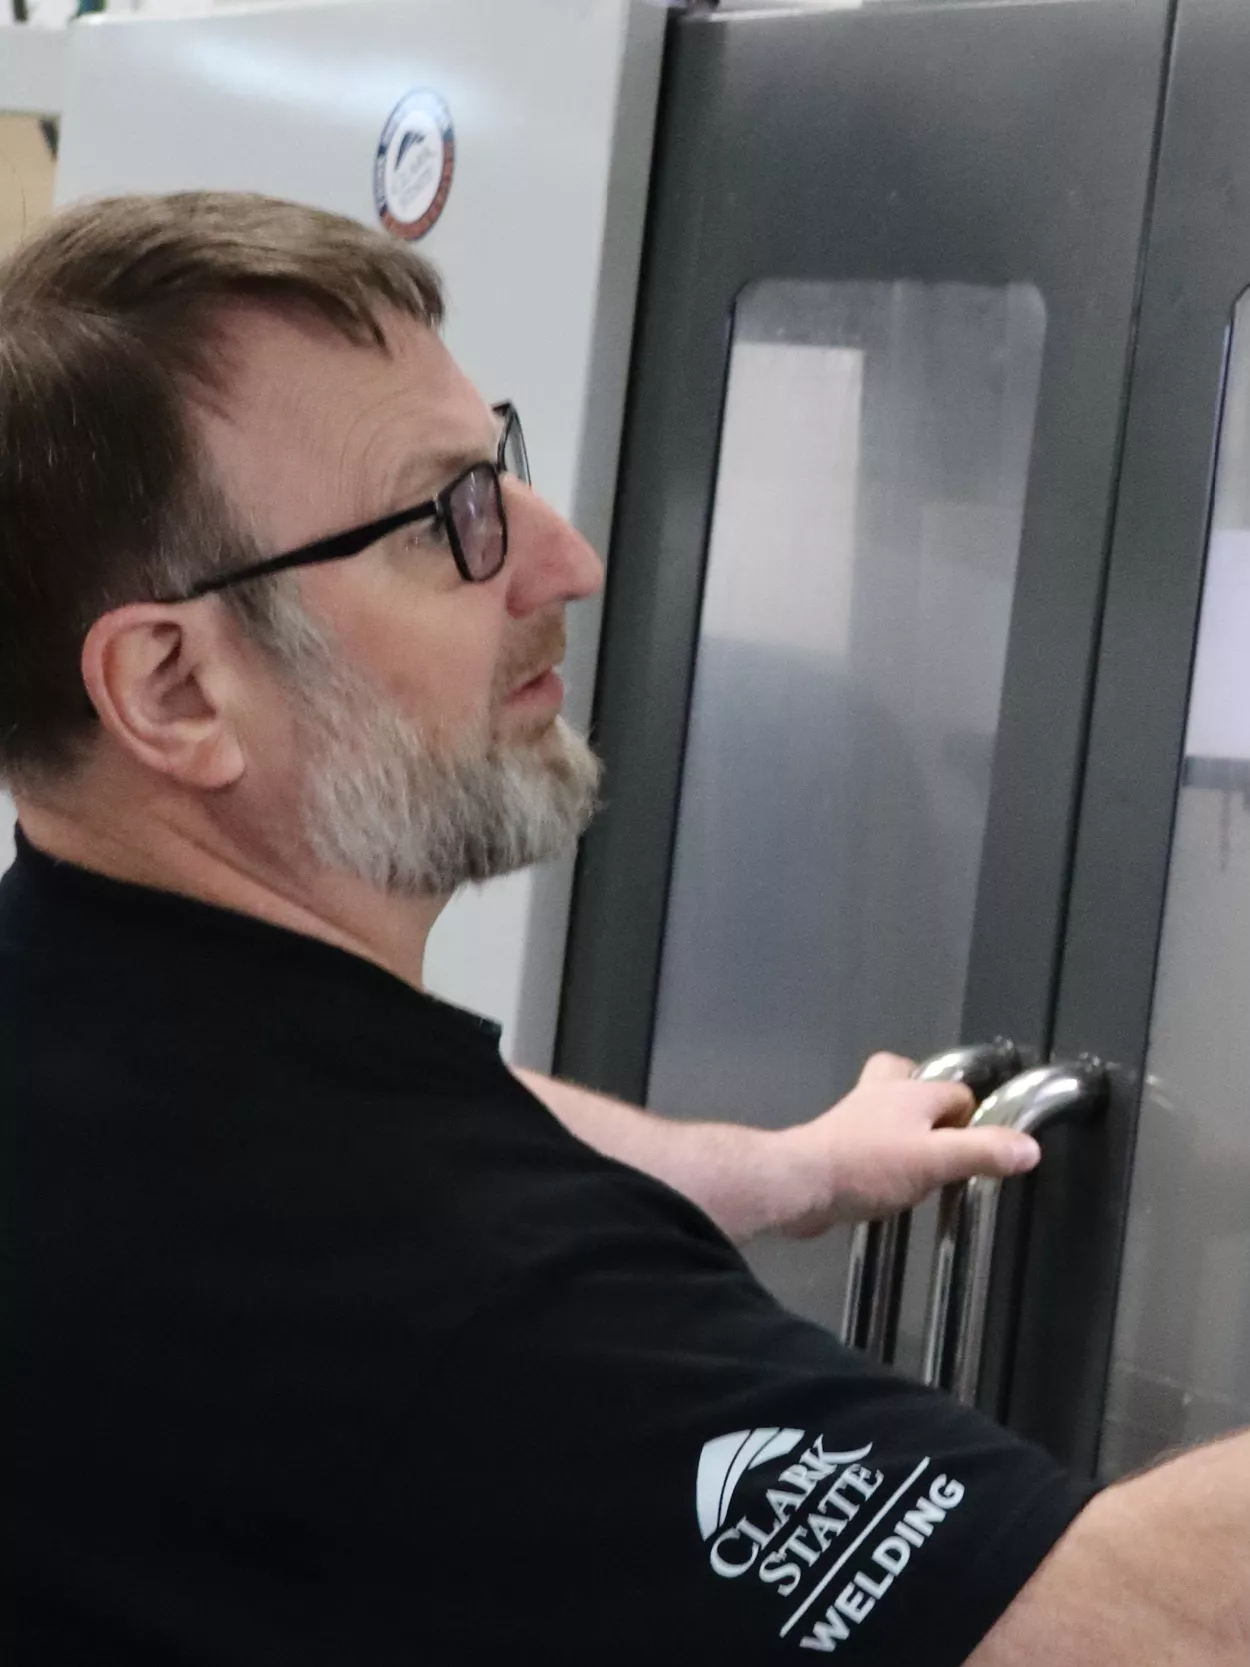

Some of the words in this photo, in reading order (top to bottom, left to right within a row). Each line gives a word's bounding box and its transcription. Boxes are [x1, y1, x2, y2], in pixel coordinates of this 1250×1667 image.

[710, 1433, 874, 1578] CLARK
[759, 1463, 884, 1597] STATE
[799, 1473, 965, 1653] WELDING
